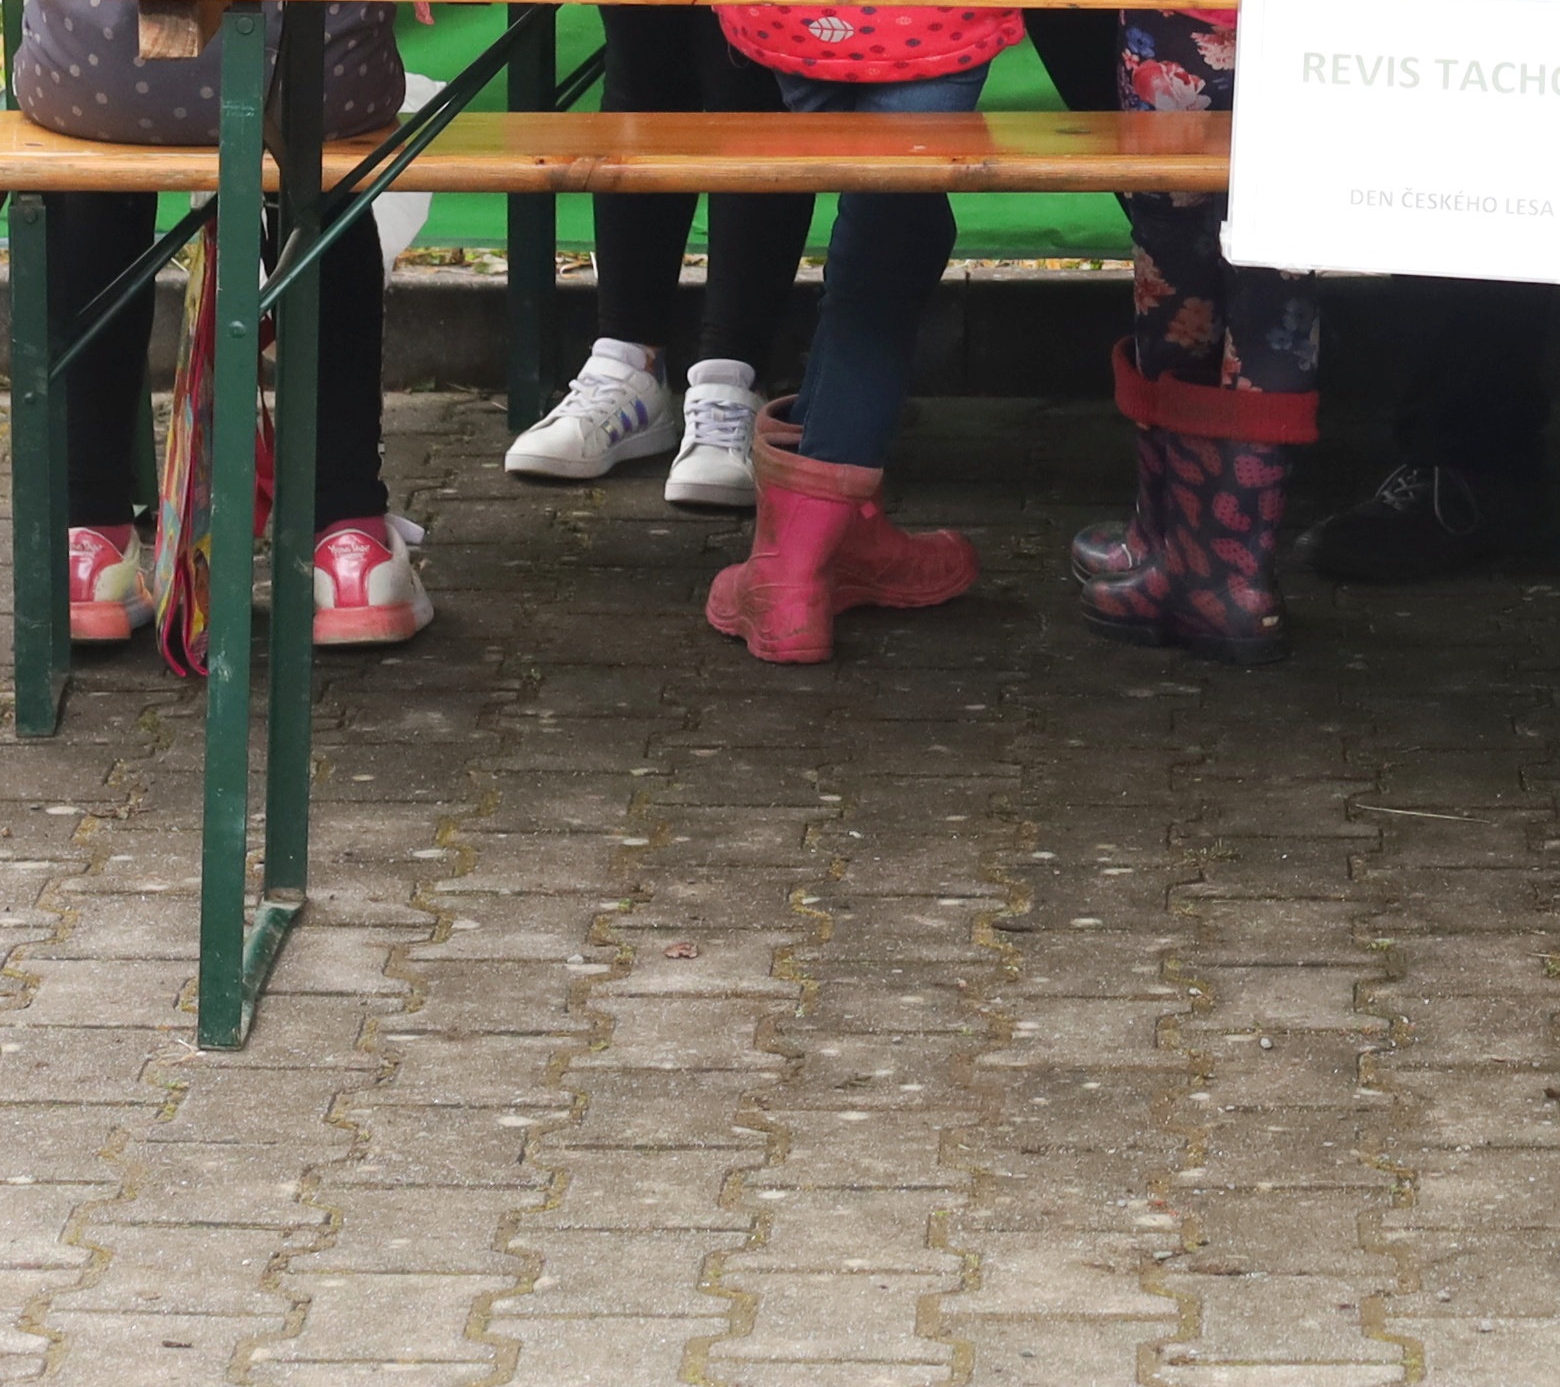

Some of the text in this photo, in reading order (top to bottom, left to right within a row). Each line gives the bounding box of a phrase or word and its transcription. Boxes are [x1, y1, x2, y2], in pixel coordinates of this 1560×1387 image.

[1302, 51, 1421, 90] REVIS
[1349, 186, 1555, 217] DEN ČESKÉHO LESA
